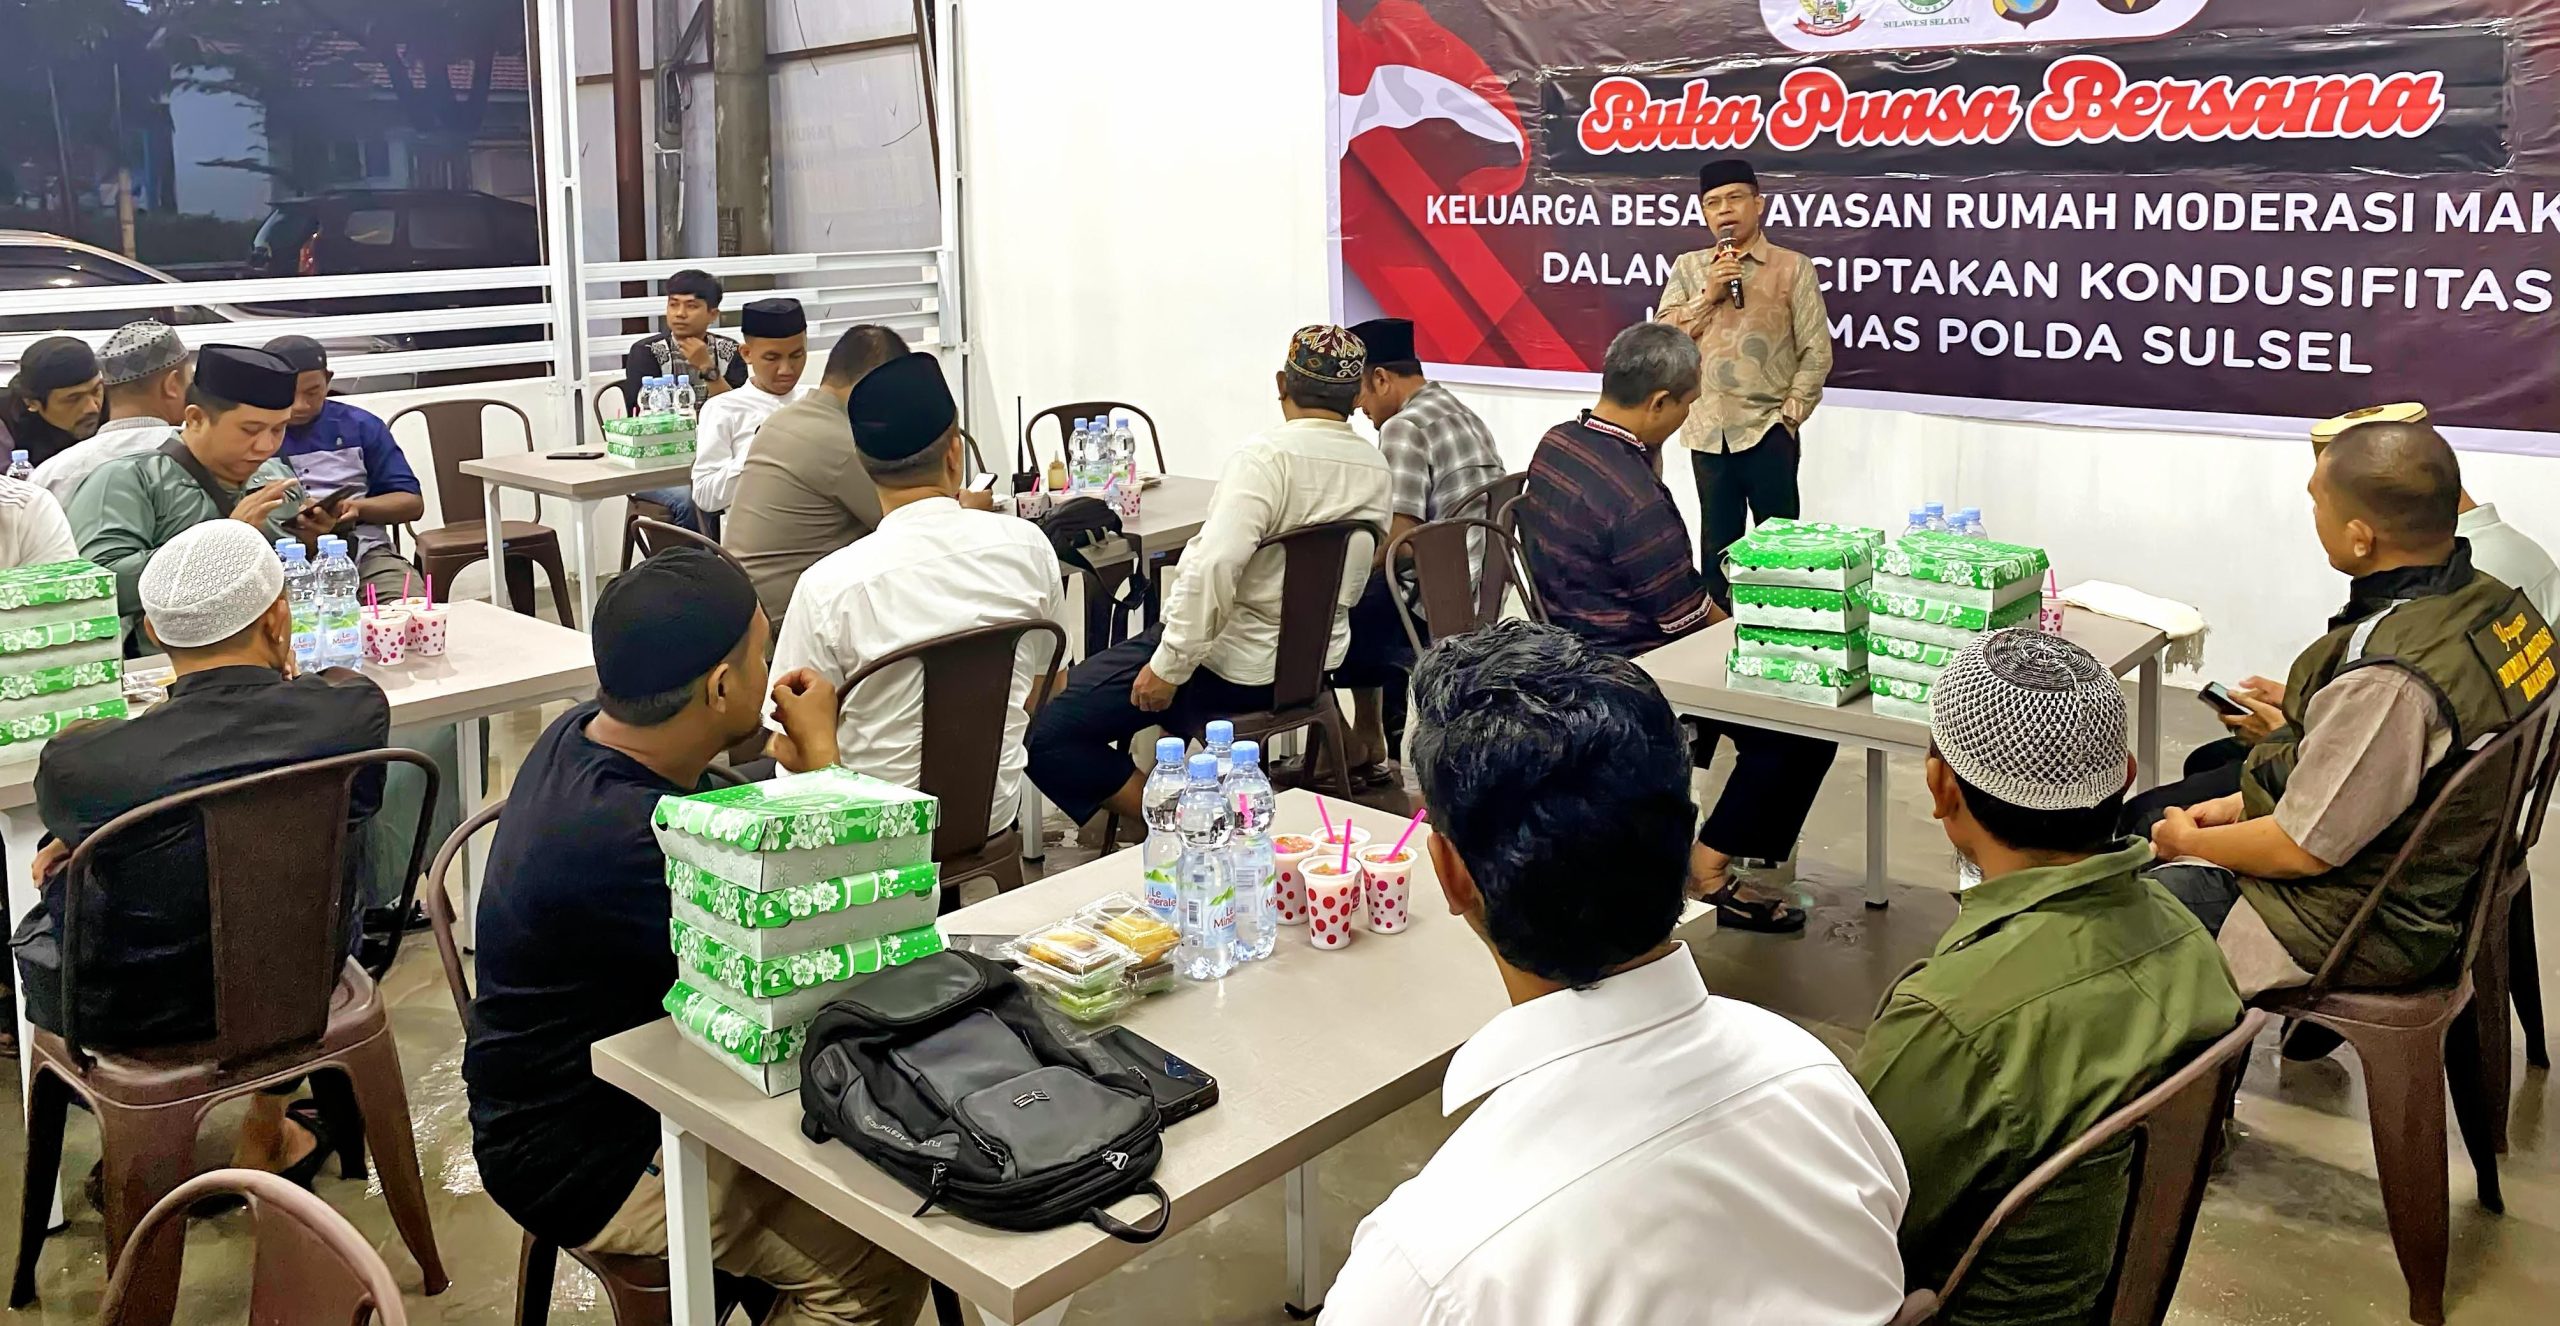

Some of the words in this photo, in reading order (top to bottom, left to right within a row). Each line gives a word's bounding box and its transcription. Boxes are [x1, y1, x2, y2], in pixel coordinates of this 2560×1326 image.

[1882, 20, 1928, 29] SULAWESI
[1929, 16, 1971, 27] SELATAN
[1577, 76, 1764, 155] Buka
[1767, 67, 2023, 151] Puasa
[2025, 55, 2445, 146] Bersama
[1427, 194, 1601, 226] KELUARGA
[1611, 194, 1709, 227] BESA
[1763, 193, 1931, 228] AYASAN
[1947, 193, 2117, 230] RUMAH
[2134, 192, 2415, 232] MODERASI
[1811, 256, 2058, 299] CIPTAKAN
[2080, 261, 2553, 313] KONDUSIFITAS
[1939, 318, 2123, 362] POLDA
[2142, 325, 2373, 374] SULSEL
[1151, 886, 1162, 898] Le
